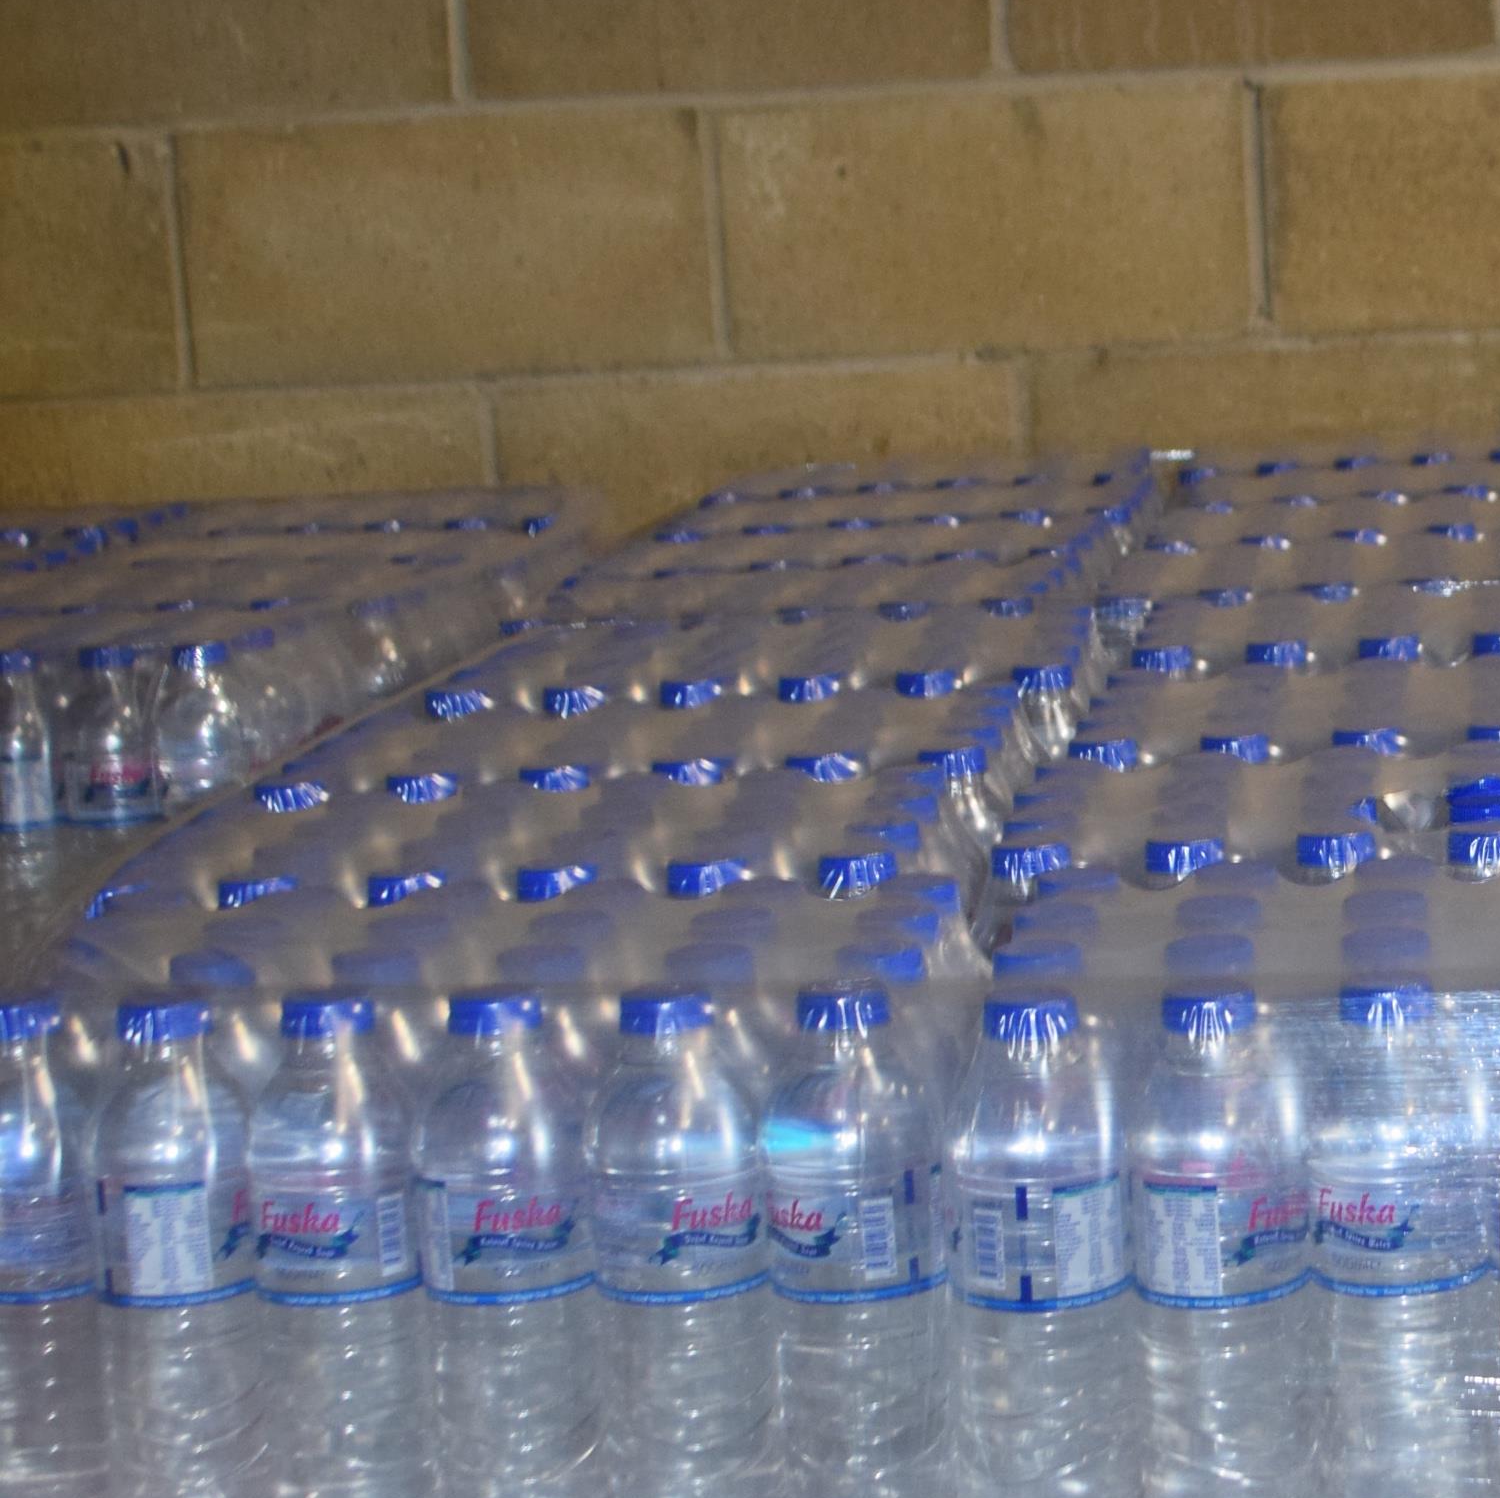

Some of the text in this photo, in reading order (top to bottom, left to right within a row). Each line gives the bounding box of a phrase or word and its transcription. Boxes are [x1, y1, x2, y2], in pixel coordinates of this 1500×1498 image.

[261, 1199, 341, 1234] Fuska
[472, 1196, 561, 1233] Fuska
[671, 1191, 753, 1231] Fuska
[1318, 1186, 1396, 1225] Fuska
